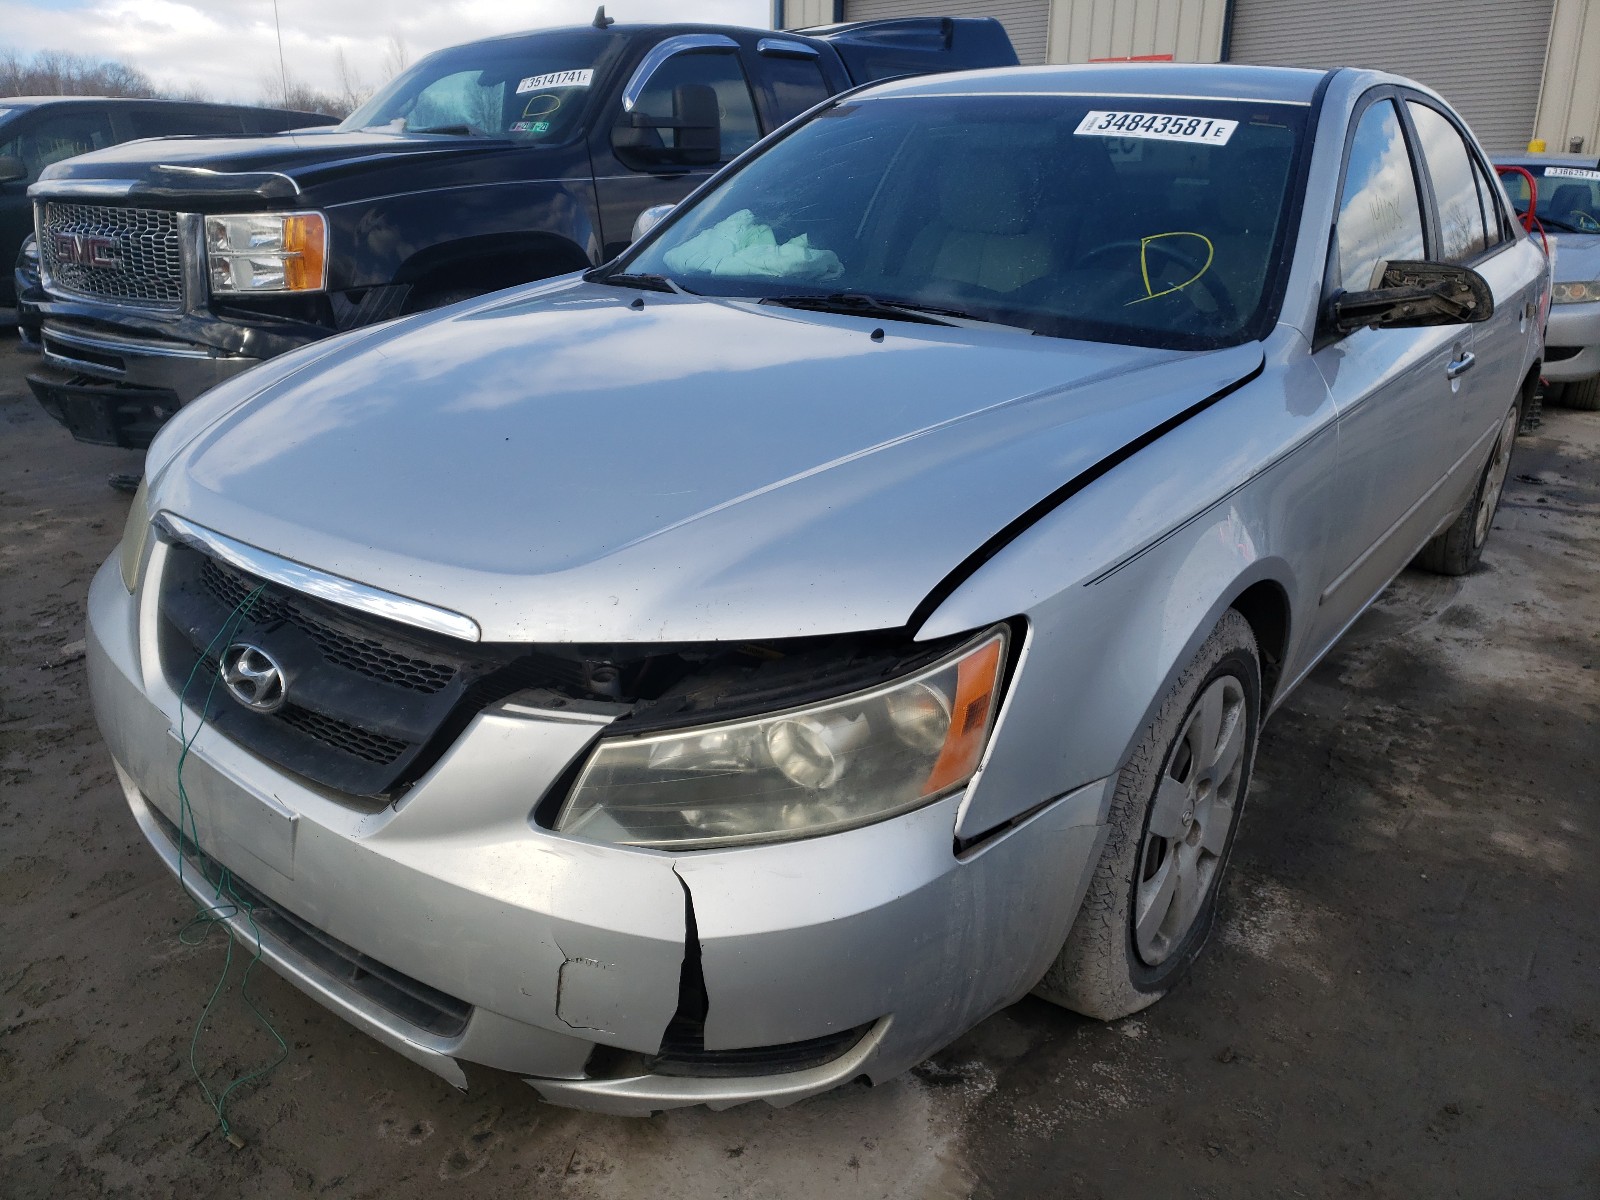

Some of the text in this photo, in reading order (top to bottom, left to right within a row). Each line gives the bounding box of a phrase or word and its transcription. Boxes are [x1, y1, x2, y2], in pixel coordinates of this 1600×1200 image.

[527, 71, 583, 89] 35141741
[1097, 113, 1226, 138] 34843581 E
[54, 231, 121, 268] GMC
[1122, 231, 1214, 307] D
